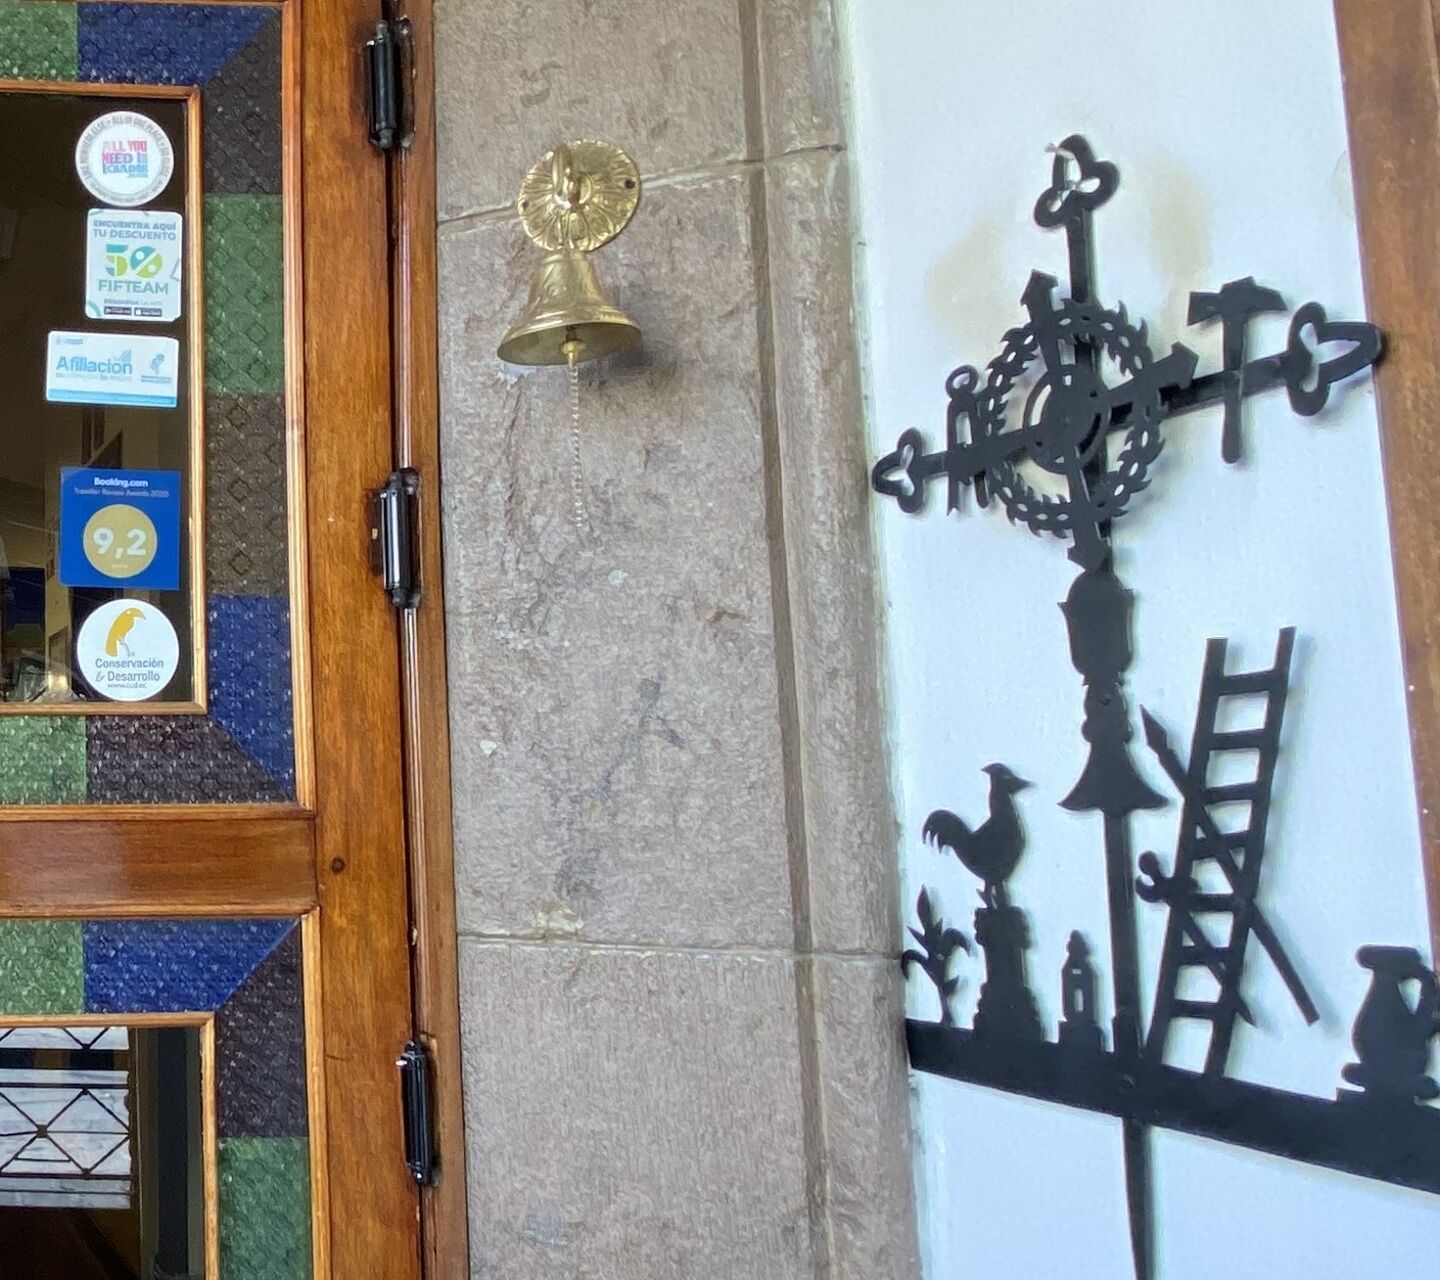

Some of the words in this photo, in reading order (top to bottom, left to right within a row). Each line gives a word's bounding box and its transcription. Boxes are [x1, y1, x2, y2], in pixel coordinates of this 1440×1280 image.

[127, 140, 148, 152] YOU
[102, 152, 133, 164] NEED
[93, 219, 150, 229] ENCUENTRA
[93, 229, 107, 238] TU
[109, 229, 177, 241] DESCUENTO
[98, 279, 169, 295] FIFTEAM
[94, 477, 149, 489] Booking.com
[93, 527, 148, 559] 9,2
[95, 657, 164, 669] Conservación
[107, 670, 160, 682] Desarrollo
